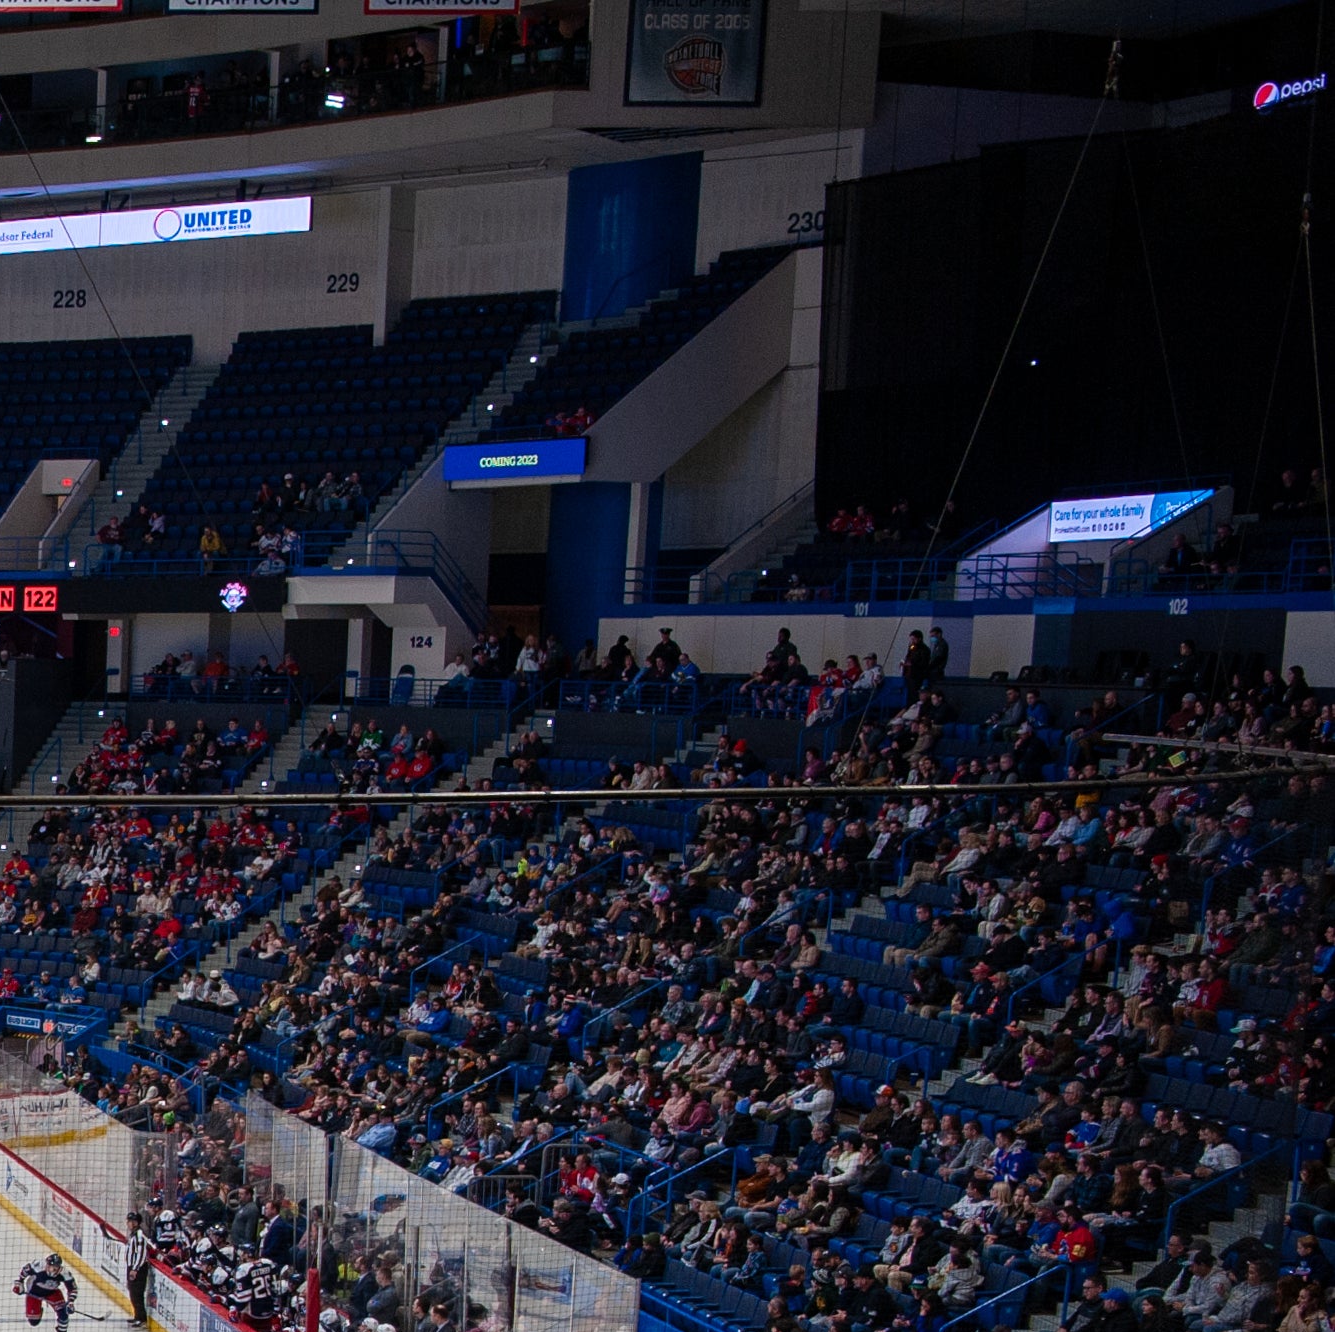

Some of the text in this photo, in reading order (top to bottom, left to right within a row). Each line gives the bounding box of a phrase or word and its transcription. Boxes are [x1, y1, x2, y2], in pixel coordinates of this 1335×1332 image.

[644, 14, 688, 30] CLASS
[693, 14, 710, 30] OF
[1281, 73, 1326, 101] pepsi
[184, 208, 252, 229] UNITED
[787, 210, 827, 234] 230
[20, 229, 53, 241] Federal
[326, 272, 360, 294] 229
[53, 289, 86, 309] 228
[480, 454, 538, 468] COMING 2023
[1054, 503, 1145, 523] Care for your whole family
[25, 590, 57, 607] 122
[1168, 598, 1188, 615] 102
[854, 602, 869, 617] 101
[409, 635, 433, 648] 124
